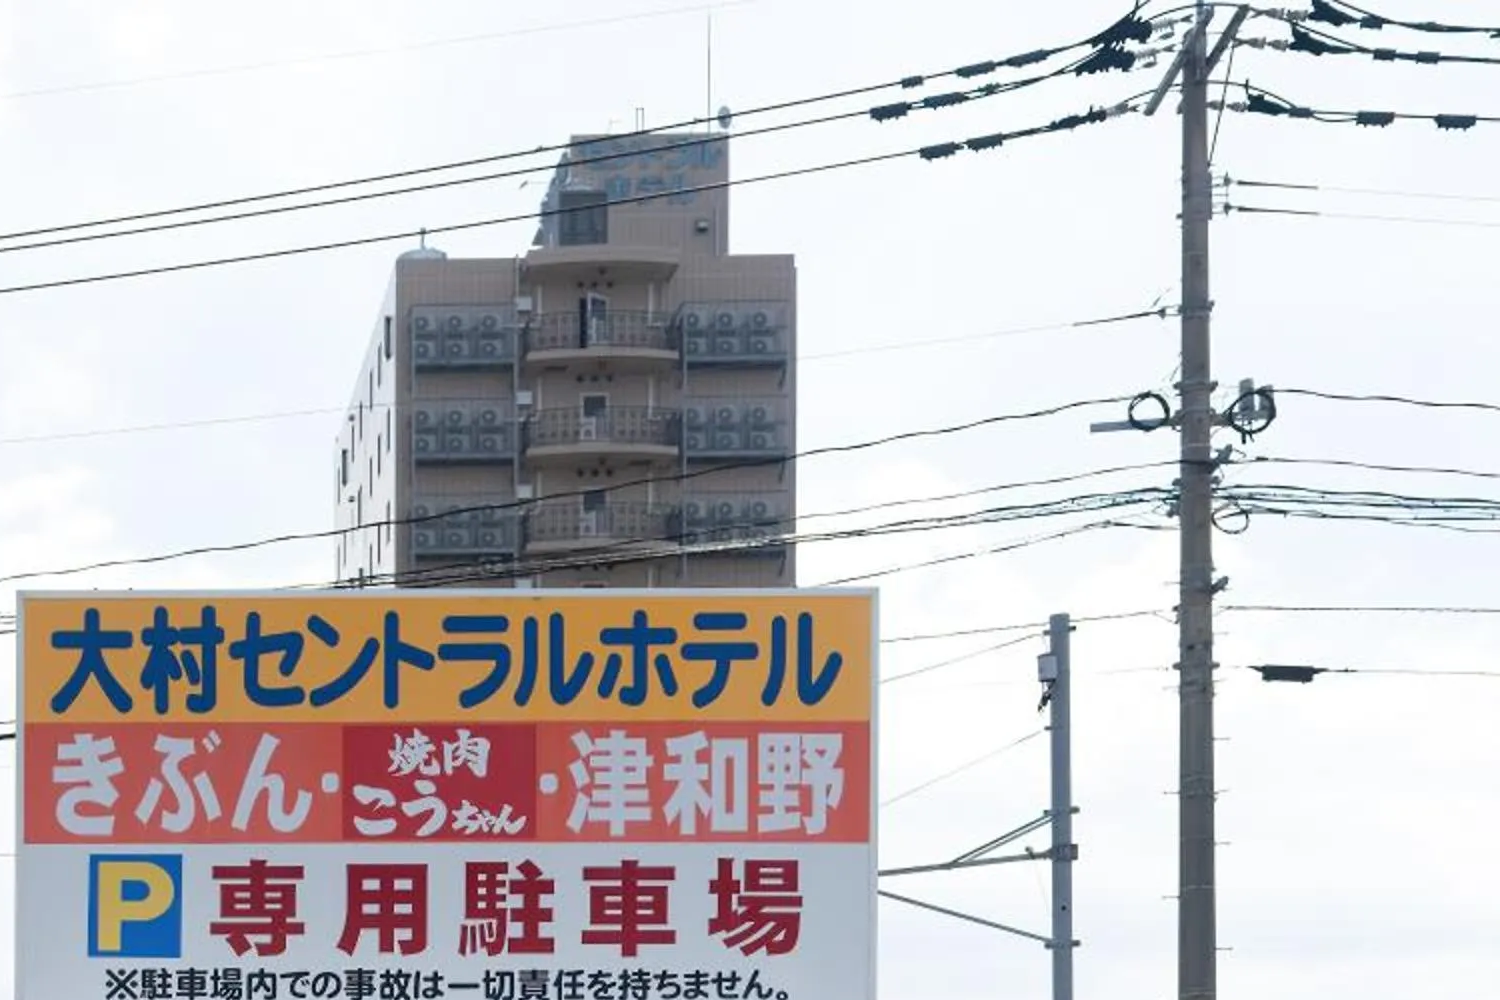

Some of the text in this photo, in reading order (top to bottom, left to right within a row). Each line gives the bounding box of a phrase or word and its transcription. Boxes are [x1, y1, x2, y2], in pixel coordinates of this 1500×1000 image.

[51, 607, 843, 714] 大村セントラルホテル
[389, 730, 491, 778] 焼肉
[353, 780, 527, 838] こうちゃん
[212, 859, 803, 957] 専用駐車場
